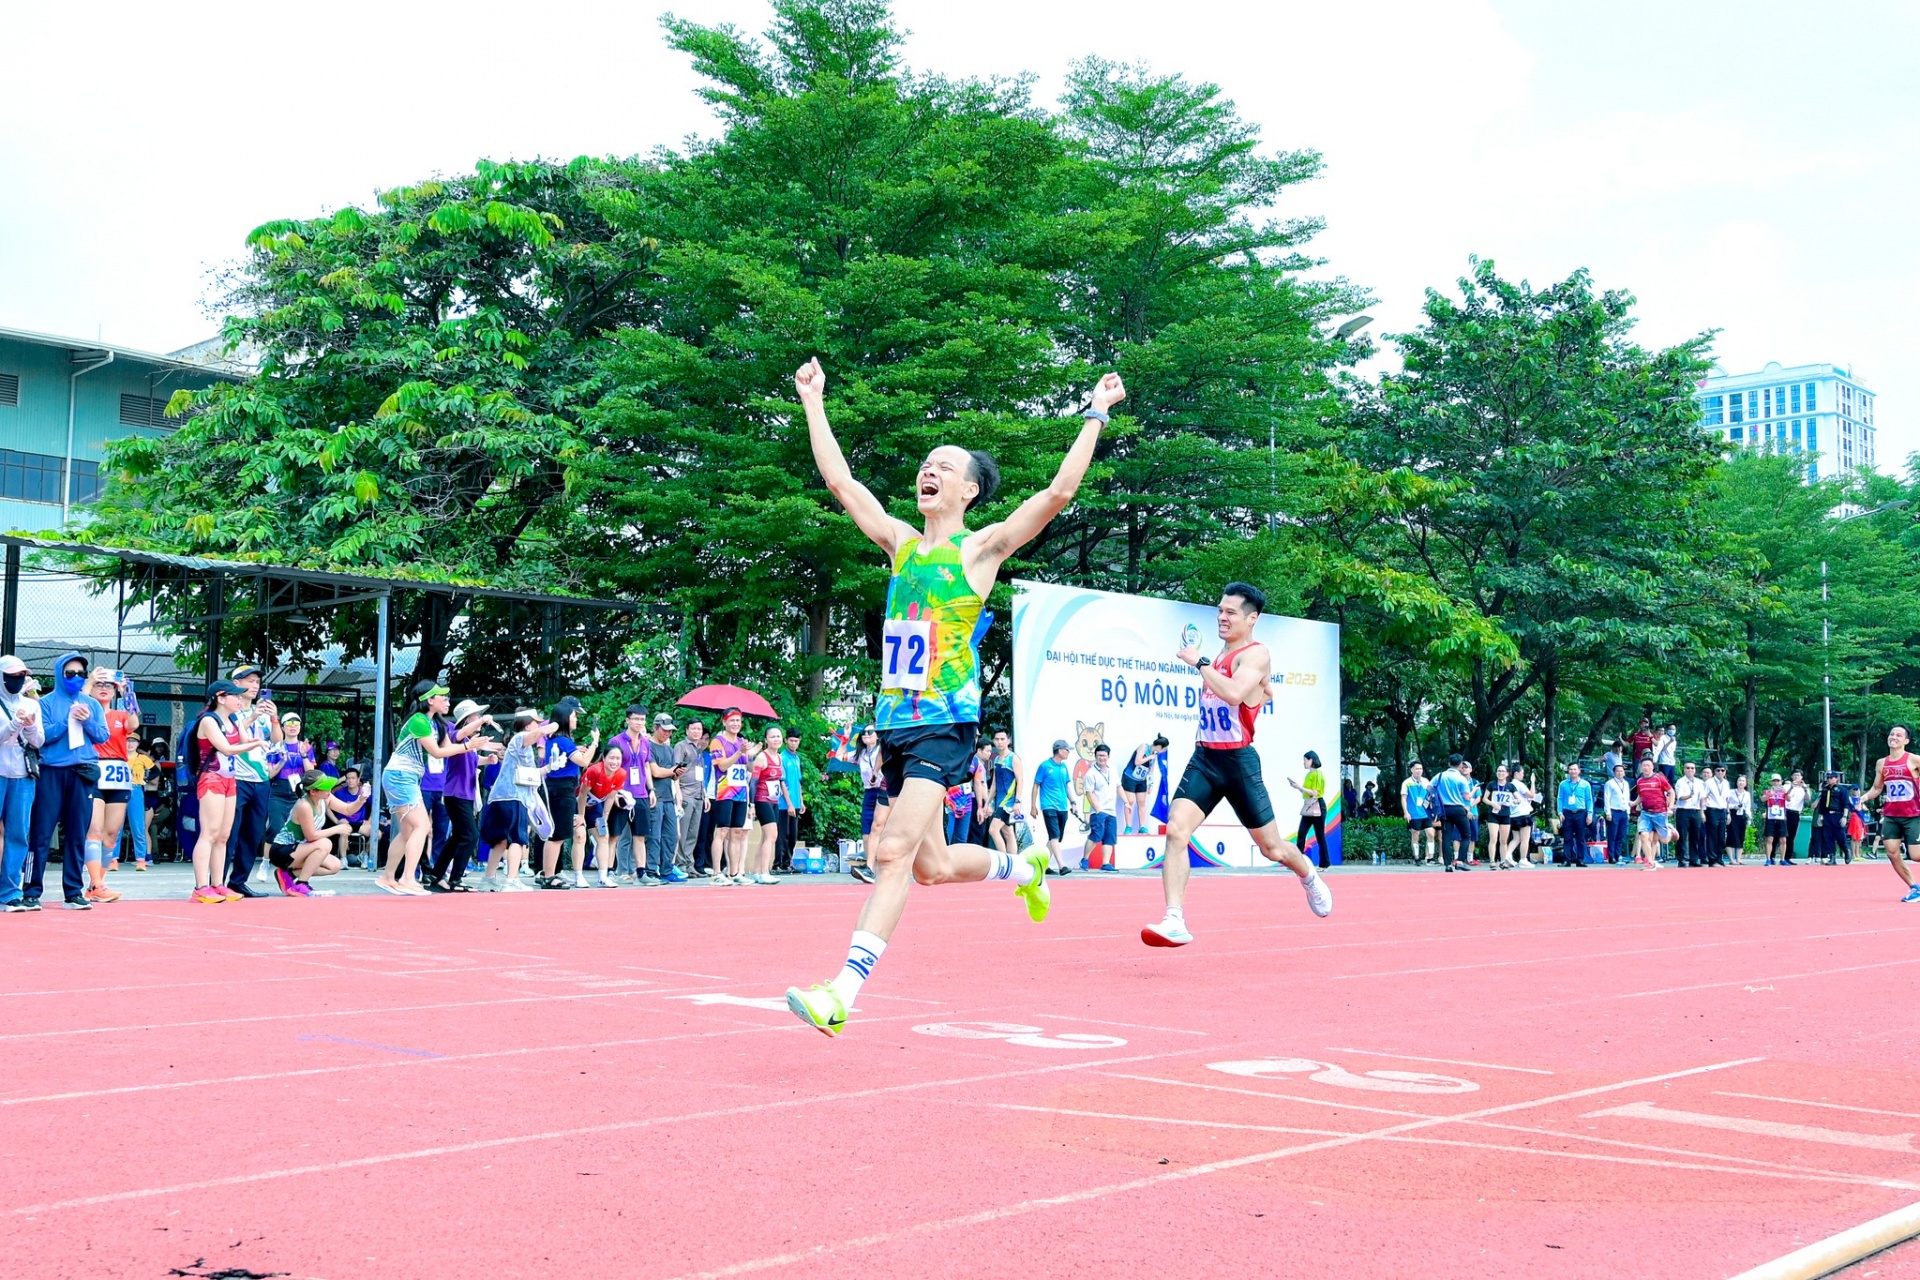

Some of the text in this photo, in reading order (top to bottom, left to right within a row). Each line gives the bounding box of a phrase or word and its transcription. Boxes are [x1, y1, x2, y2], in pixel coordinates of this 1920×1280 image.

[885, 635, 925, 675] 72
[1046, 650, 1061, 663] ĐẠI
[1063, 651, 1078, 665] HỘI
[1134, 660, 1157, 672] THAO
[1158, 661, 1186, 675] NGÀNH
[1285, 672, 1317, 686] 2023
[1101, 674, 1127, 708] BỘ
[1134, 678, 1178, 707] MÔN
[1200, 706, 1232, 731] 318
[1890, 784, 1906, 797] 22
